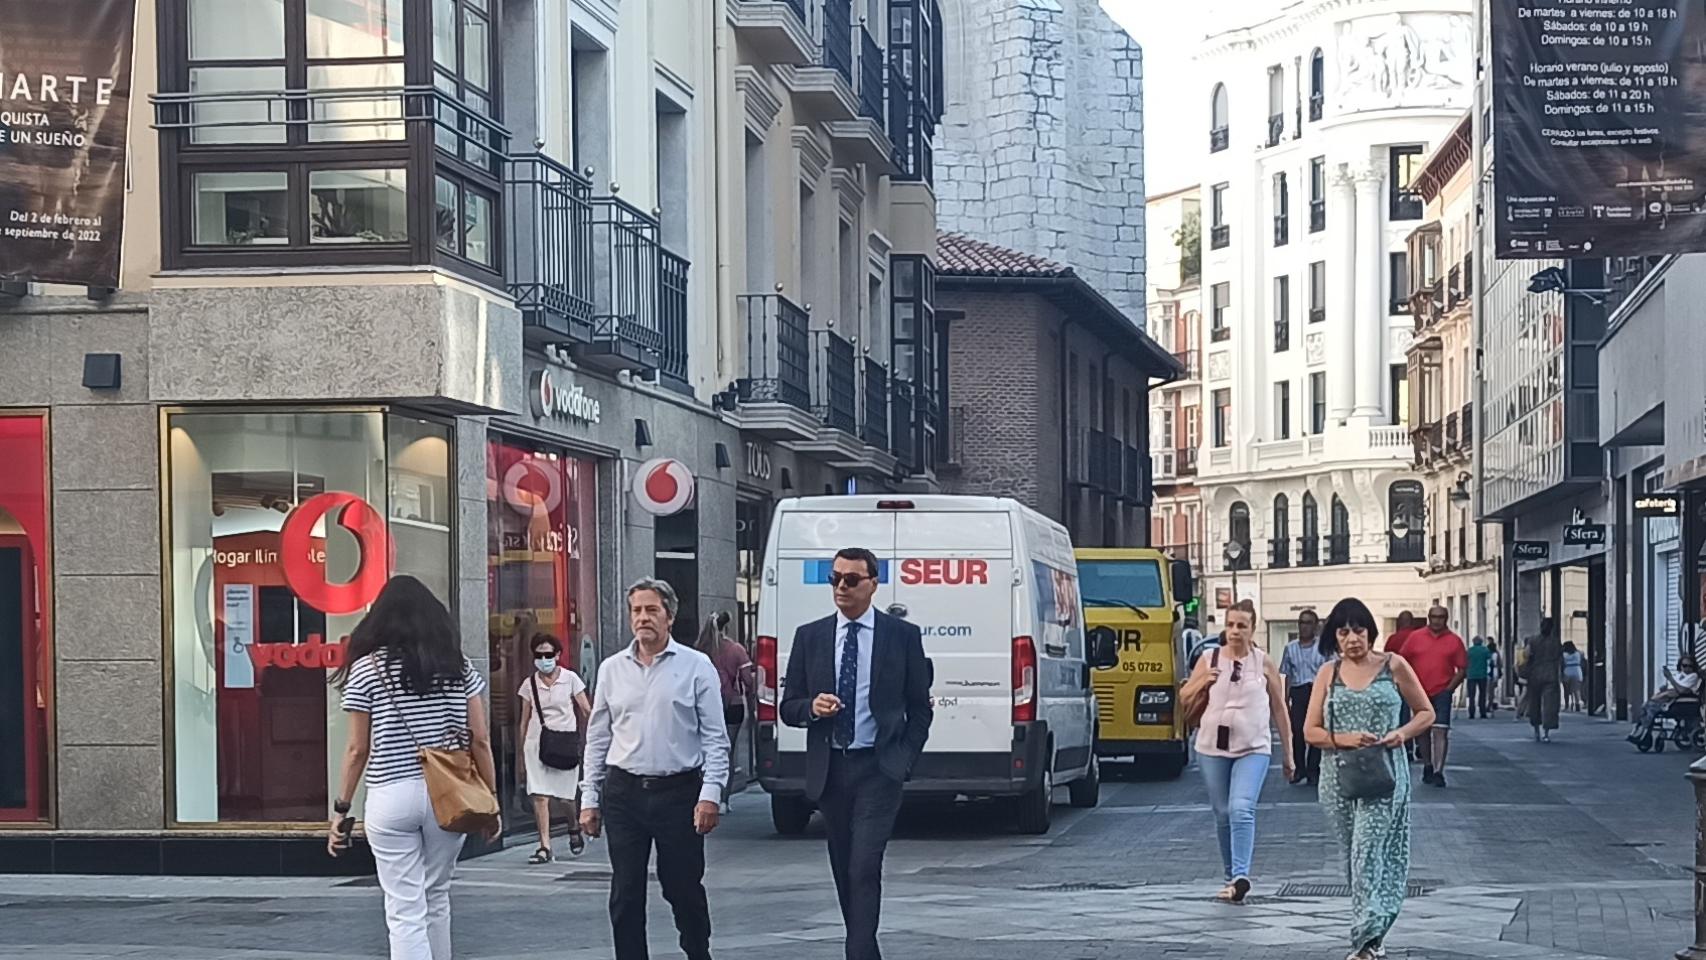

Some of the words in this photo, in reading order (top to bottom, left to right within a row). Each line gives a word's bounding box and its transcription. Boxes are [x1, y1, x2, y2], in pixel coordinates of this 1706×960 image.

[1518, 8, 1531, 18] De
[1533, 8, 1565, 17] martes
[1618, 8, 1631, 18] de
[1634, 9, 1645, 18] 10
[1657, 9, 1667, 18] 18
[1670, 9, 1677, 18] h
[1590, 21, 1602, 31] de
[1605, 22, 1616, 32] 10
[1628, 22, 1640, 32] 19
[1642, 22, 1648, 32] h
[1541, 34, 1591, 47] Domingos:
[1593, 35, 1605, 46] de
[1608, 36, 1619, 46] 10
[1622, 38, 1628, 46] a
[1632, 36, 1643, 46] 15
[1645, 36, 1651, 46] h
[1530, 63, 1563, 73] Horario
[1566, 63, 1598, 72] verano
[1624, 65, 1631, 75] y
[1523, 75, 1536, 86] De
[1538, 77, 1569, 87] martes
[1619, 76, 1632, 86] de
[1635, 77, 1644, 85] 11
[1670, 77, 1677, 86] h
[1593, 89, 1605, 99] de
[1608, 90, 1618, 98] 11
[1621, 91, 1627, 99] a
[1629, 90, 1641, 99] 20
[1643, 90, 1650, 99] h
[1544, 104, 1594, 116] Domingos:
[1596, 103, 1608, 113] de
[1612, 103, 1621, 112] 11
[1625, 105, 1631, 113] a
[1634, 104, 1645, 113] 15
[1647, 104, 1654, 113] h
[0, 111, 50, 126] QUISTA
[10, 131, 31, 143] UN
[35, 130, 86, 147] SUEÑO
[10, 210, 28, 223] Del
[31, 212, 38, 223] 2
[40, 213, 52, 224] de
[54, 213, 91, 226] febrero
[5, 227, 59, 240] septiembre
[62, 230, 75, 240] de
[78, 230, 101, 241] 2022
[555, 383, 600, 424] vodafone
[1571, 529, 1599, 540] Sfera
[1517, 543, 1543, 554] Sfera
[900, 558, 988, 585] SEUR
[1122, 662, 1136, 672] 05
[1138, 662, 1163, 673] 0782
[938, 696, 958, 708] dpd
